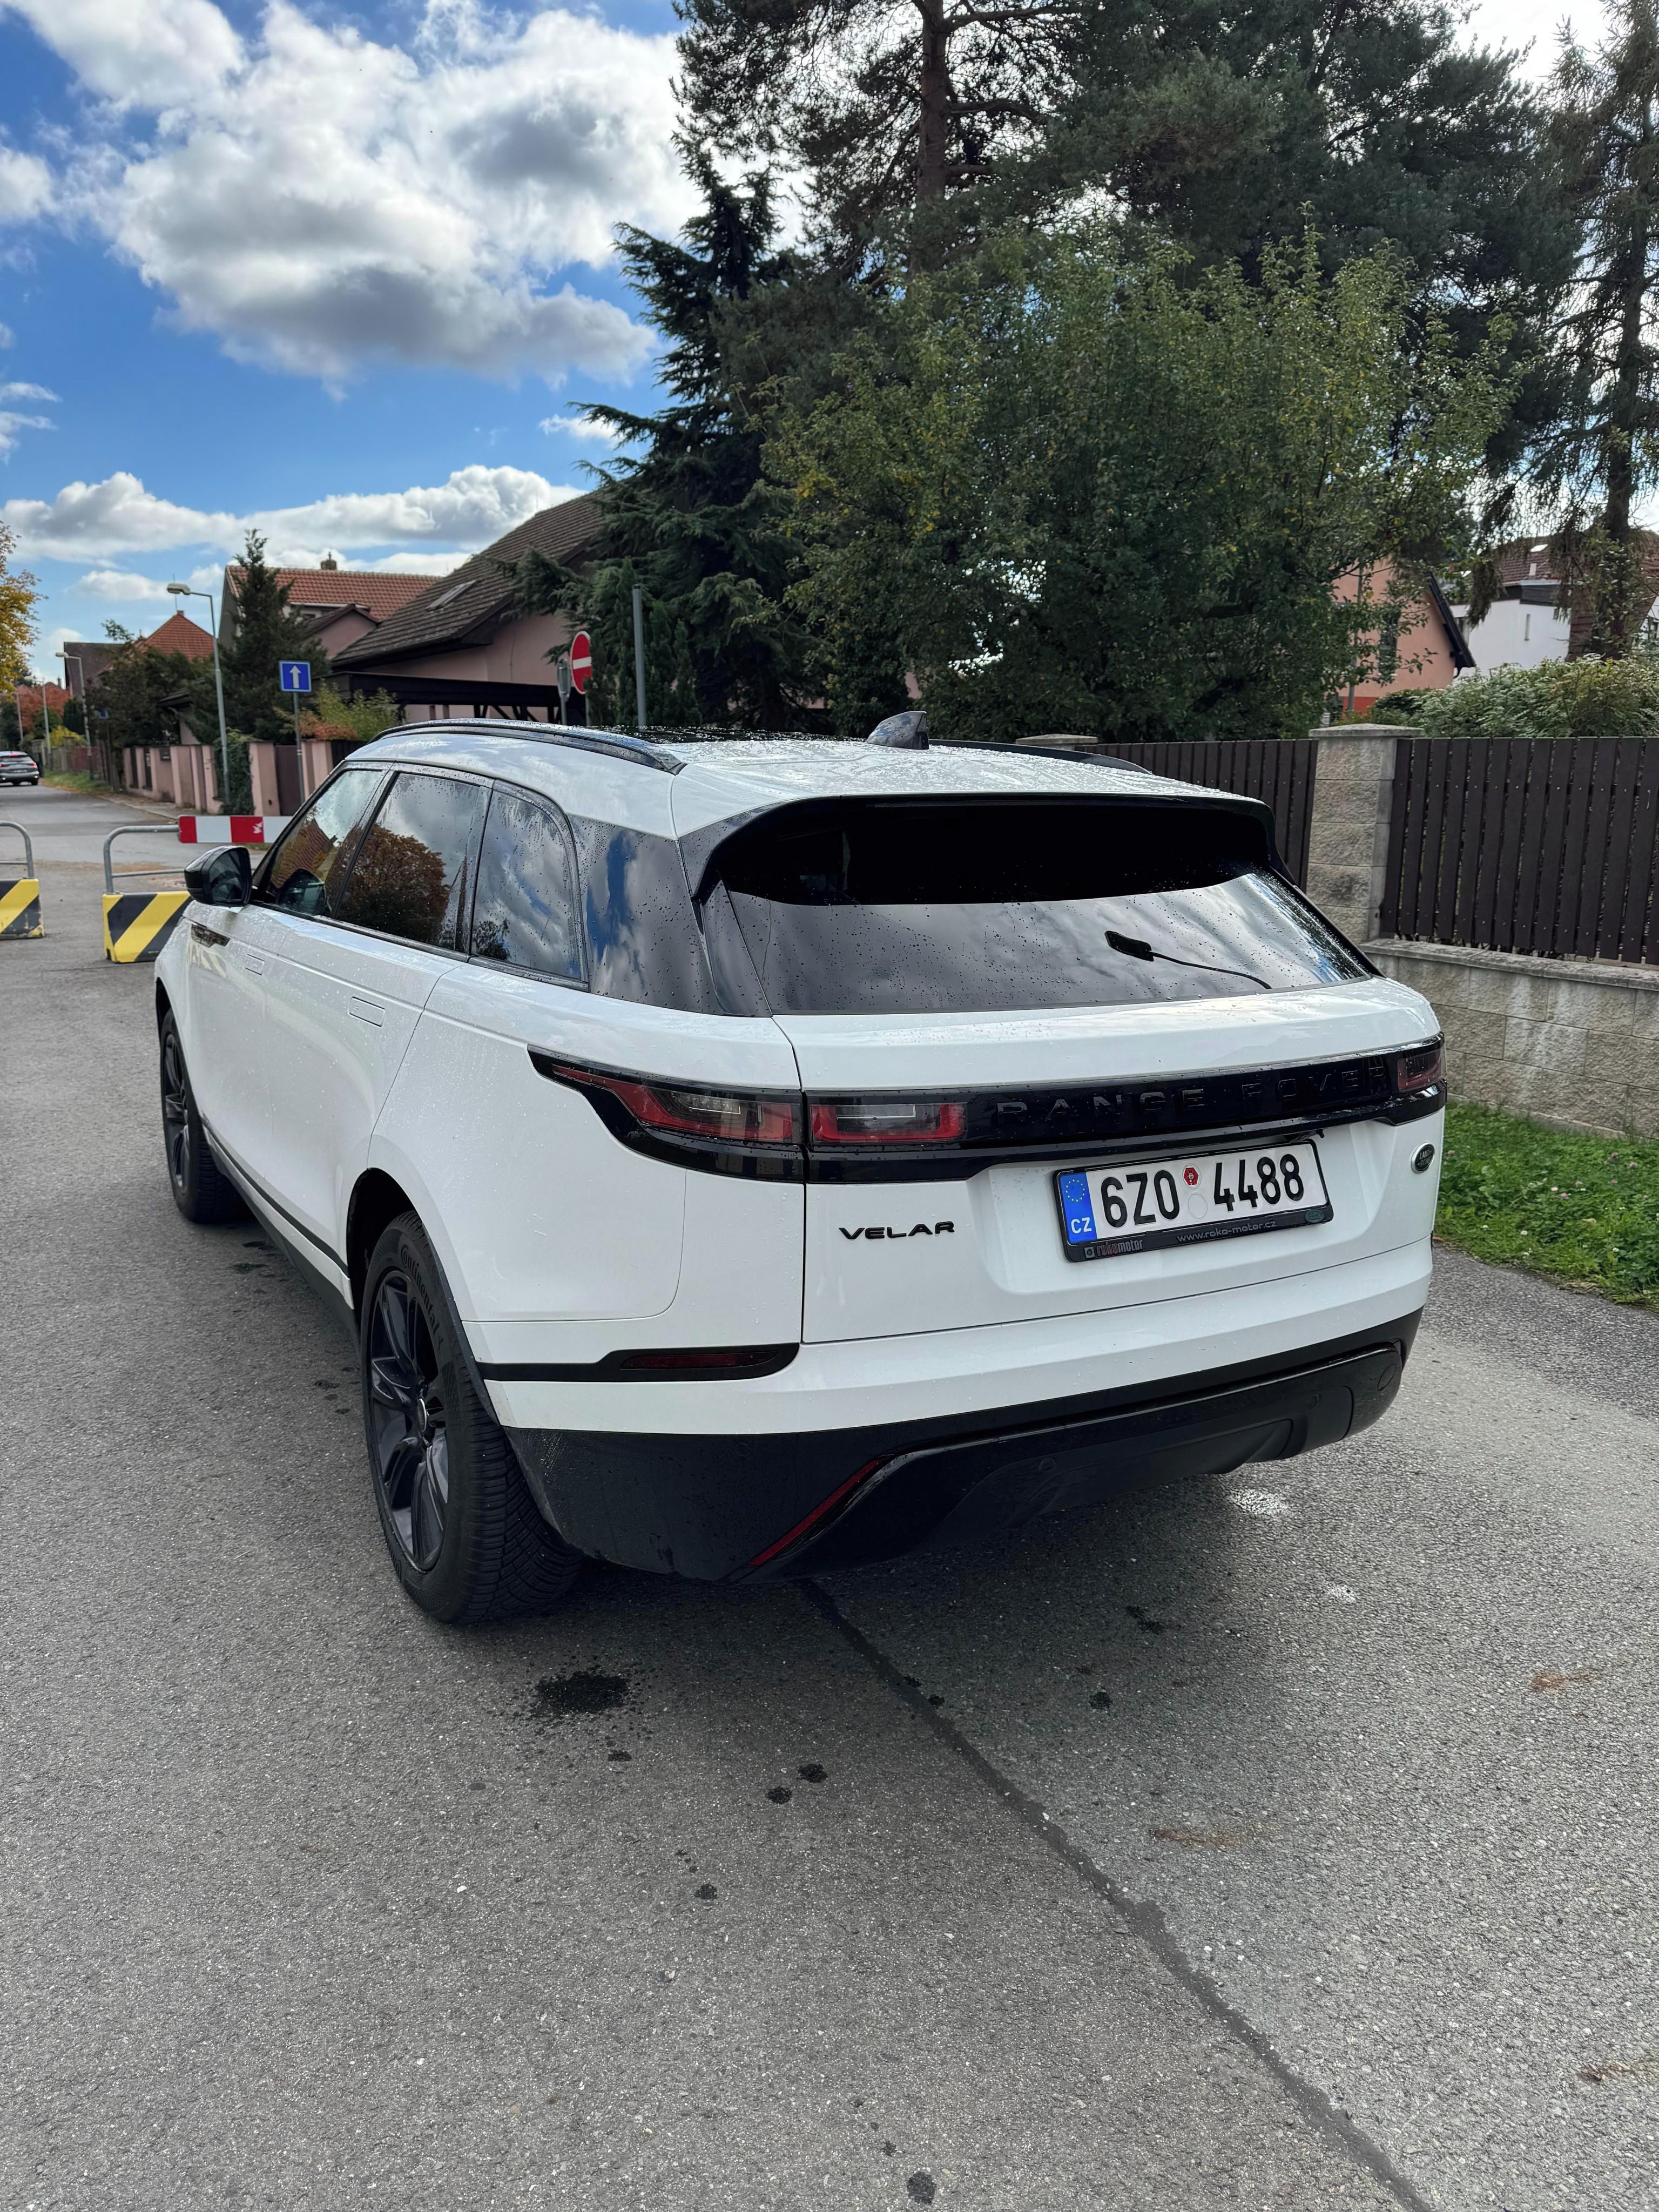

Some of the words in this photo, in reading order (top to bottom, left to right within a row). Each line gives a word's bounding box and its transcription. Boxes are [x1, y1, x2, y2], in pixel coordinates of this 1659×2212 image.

[997, 1088, 1205, 1124] RANGE
[1100, 1169, 1180, 1228] 6Z0
[1213, 1154, 1304, 1211] 4488
[838, 1220, 955, 1239] VELAR
[1071, 1216, 1092, 1234] CZ
[1177, 1219, 1277, 1243] www.roko-motor.cz
[401, 1244, 441, 1334] Continental
